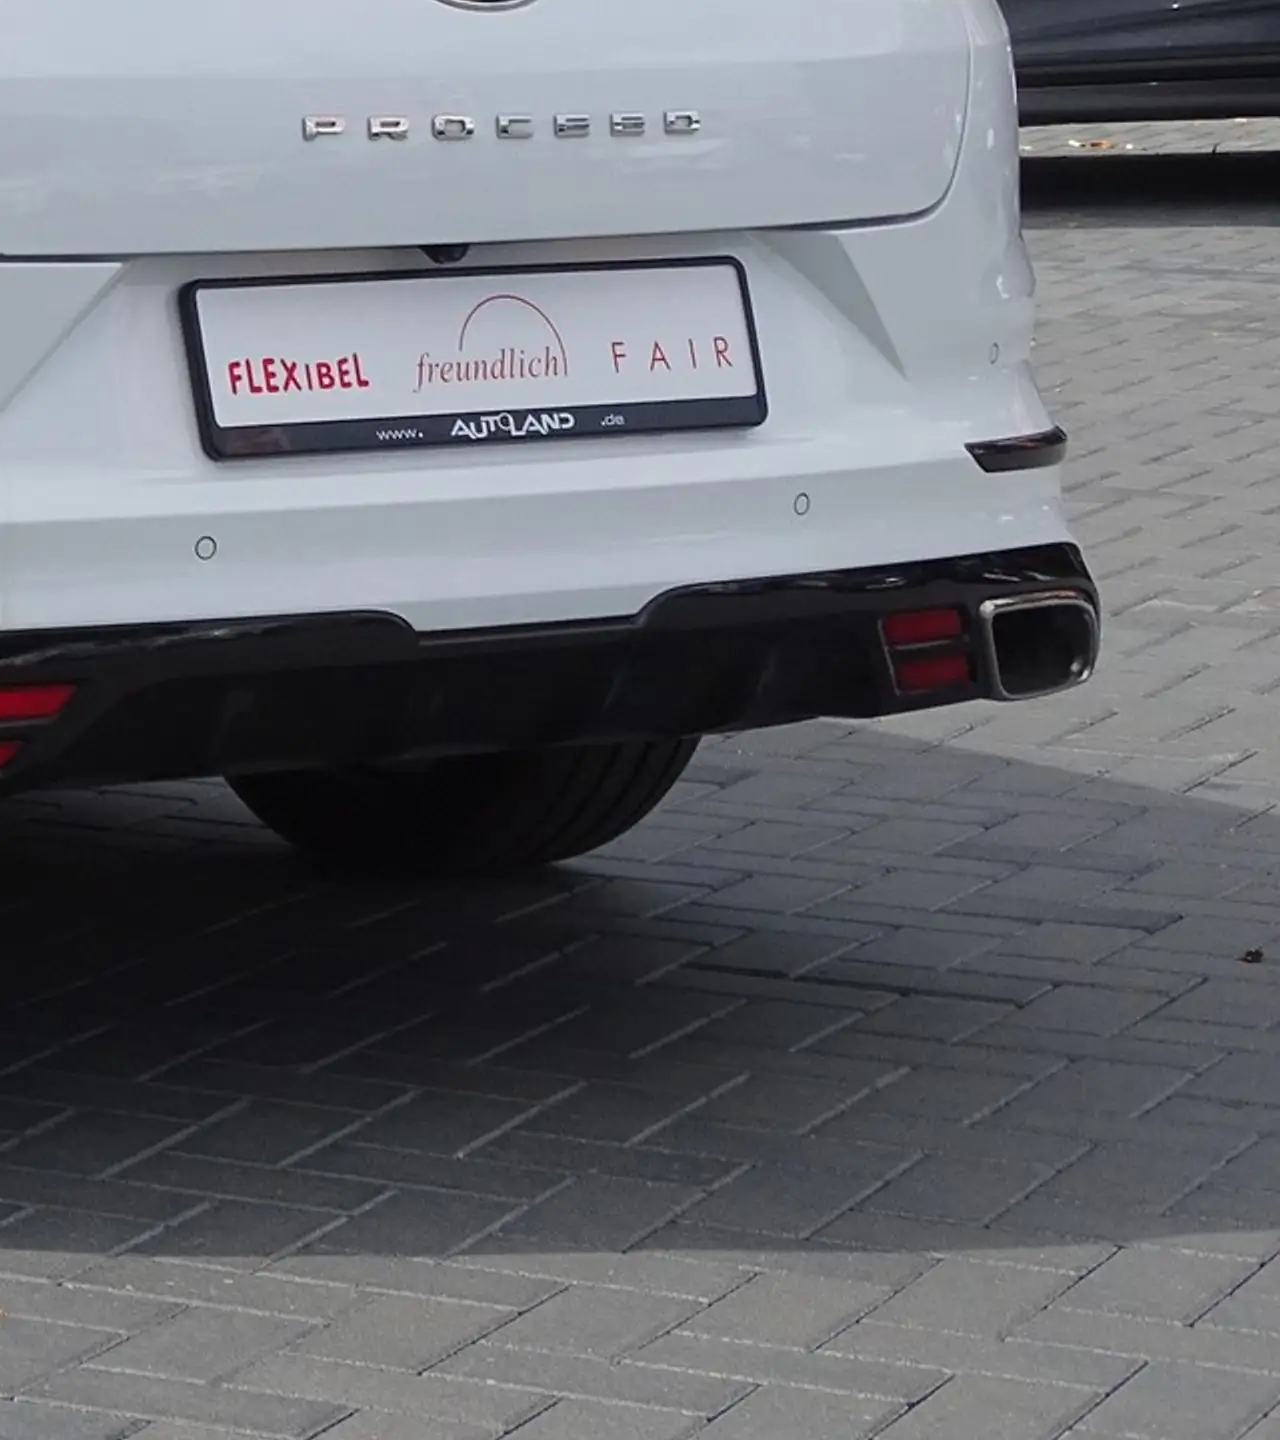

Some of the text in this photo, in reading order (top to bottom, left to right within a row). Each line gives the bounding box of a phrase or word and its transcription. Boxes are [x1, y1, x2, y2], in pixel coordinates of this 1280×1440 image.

[302, 108, 702, 142] PROCEED
[227, 336, 734, 396] FLEXIBEL freundlich FAIR
[450, 412, 575, 440] AUTOLAND
